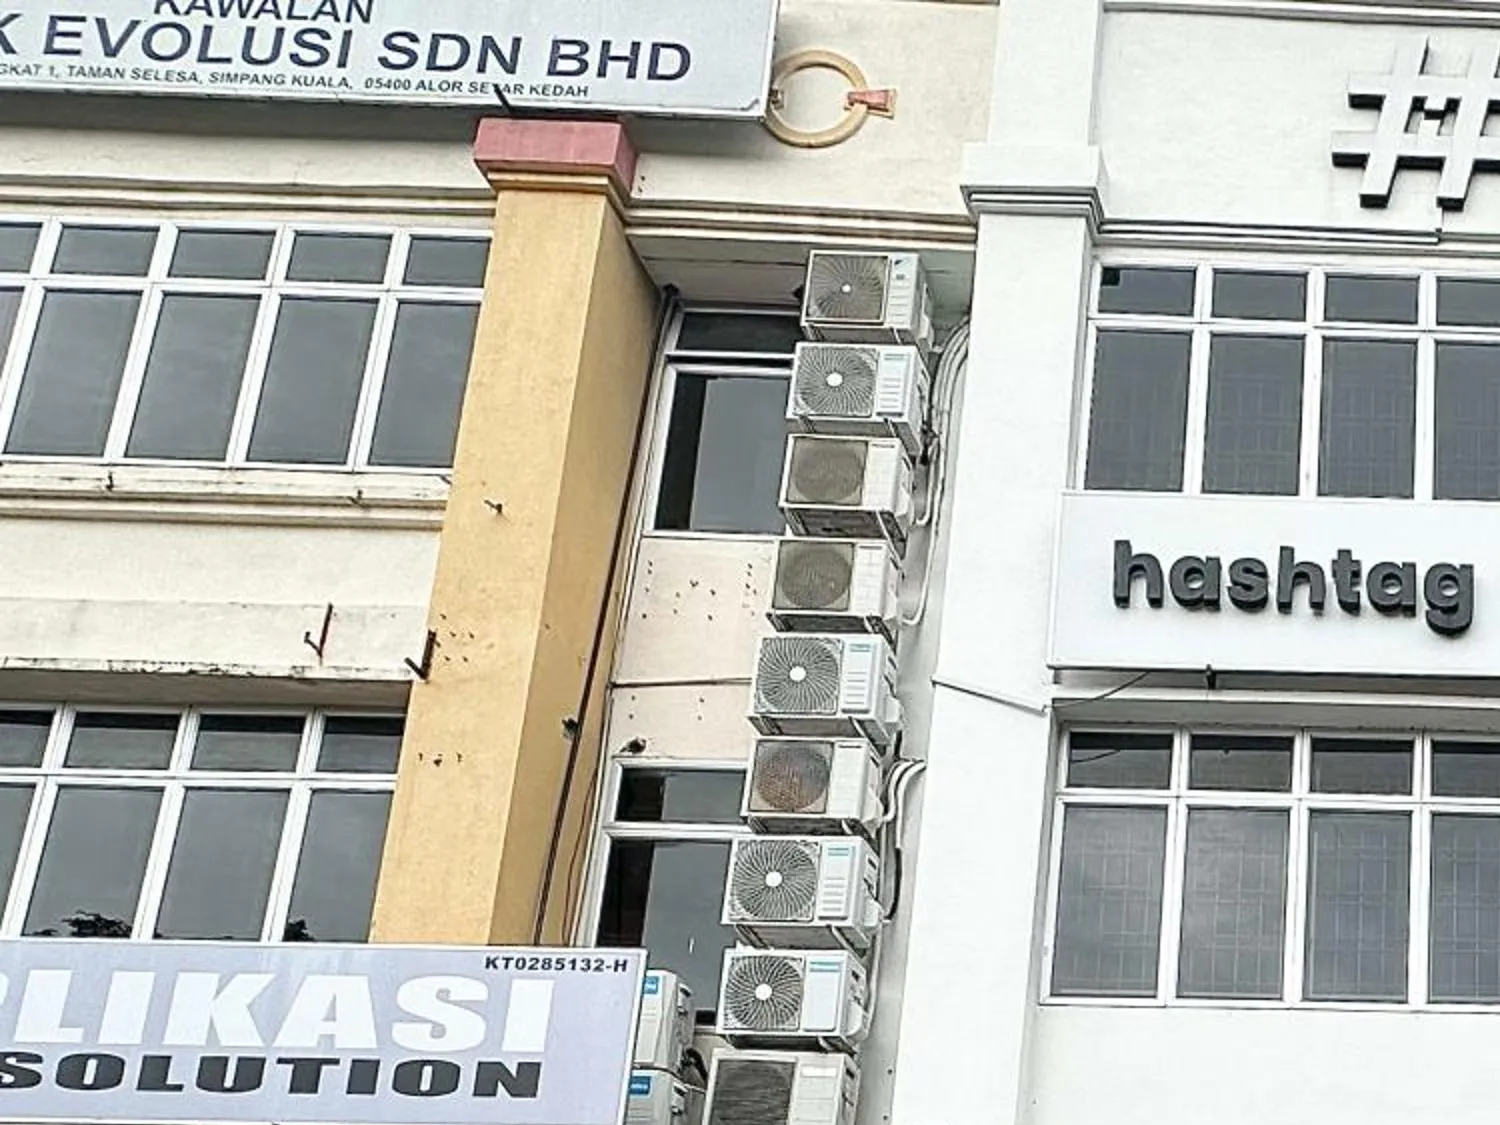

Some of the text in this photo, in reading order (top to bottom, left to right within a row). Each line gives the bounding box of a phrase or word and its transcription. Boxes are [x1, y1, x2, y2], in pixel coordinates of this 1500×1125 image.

[43, 15, 353, 68] EVOLUSI
[377, 31, 522, 75] SDN
[546, 39, 692, 81] BHD
[67, 65, 126, 79] TAMAN
[208, 71, 286, 86] SIMPANG
[364, 77, 411, 91] 05400
[415, 79, 463, 94] ALOR
[468, 81, 524, 96] SEAR
[529, 84, 588, 98] KEDAH
[1113, 539, 1475, 637] hashtag
[484, 955, 629, 973] KT0285132-H
[0, 968, 555, 1053] LIKASI
[0, 1051, 542, 1099] SOLUTION
